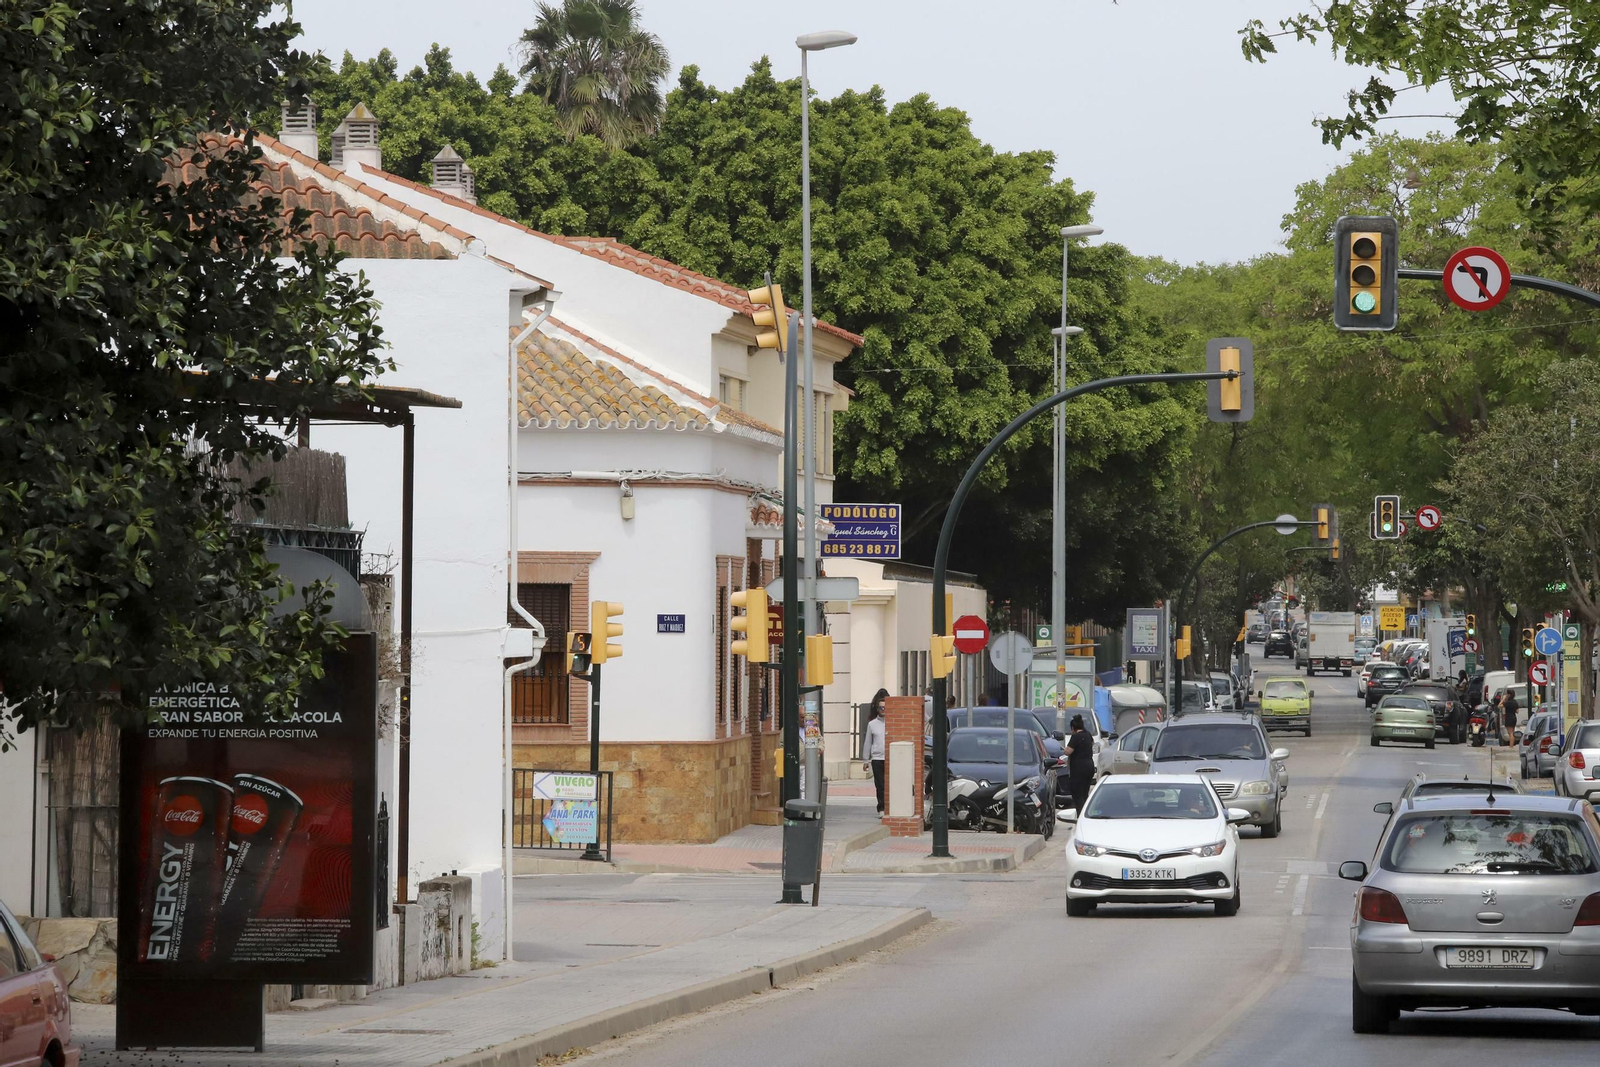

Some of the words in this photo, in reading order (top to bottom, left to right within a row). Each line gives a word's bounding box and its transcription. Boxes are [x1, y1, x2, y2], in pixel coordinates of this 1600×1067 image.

[824, 506, 896, 518] PODÓLOGO
[854, 527, 888, 538] Sánchez
[824, 544, 846, 554] 685
[850, 544, 863, 554] 23
[867, 544, 881, 554] 88
[884, 545, 896, 554] 77
[1034, 680, 1042, 706] MER
[150, 694, 240, 708] ENERGÉTICA
[152, 712, 190, 723] RAN
[194, 712, 243, 723] SABOR
[149, 729, 199, 738] EXPANDE
[202, 729, 216, 738] TU
[270, 729, 318, 738] POSITIVA
[554, 776, 594, 787] VIVERO
[252, 783, 281, 798] AZÚCAR
[551, 809, 569, 818] ANA
[573, 809, 594, 819] PARK
[186, 843, 194, 871] VITAMINS
[236, 842, 251, 868] VITAMINS
[1130, 870, 1152, 878] 3352
[1155, 870, 1172, 878] KTK
[147, 841, 183, 960] ENERGY
[1459, 949, 1491, 963] 9891
[1502, 950, 1528, 963] DRZ
